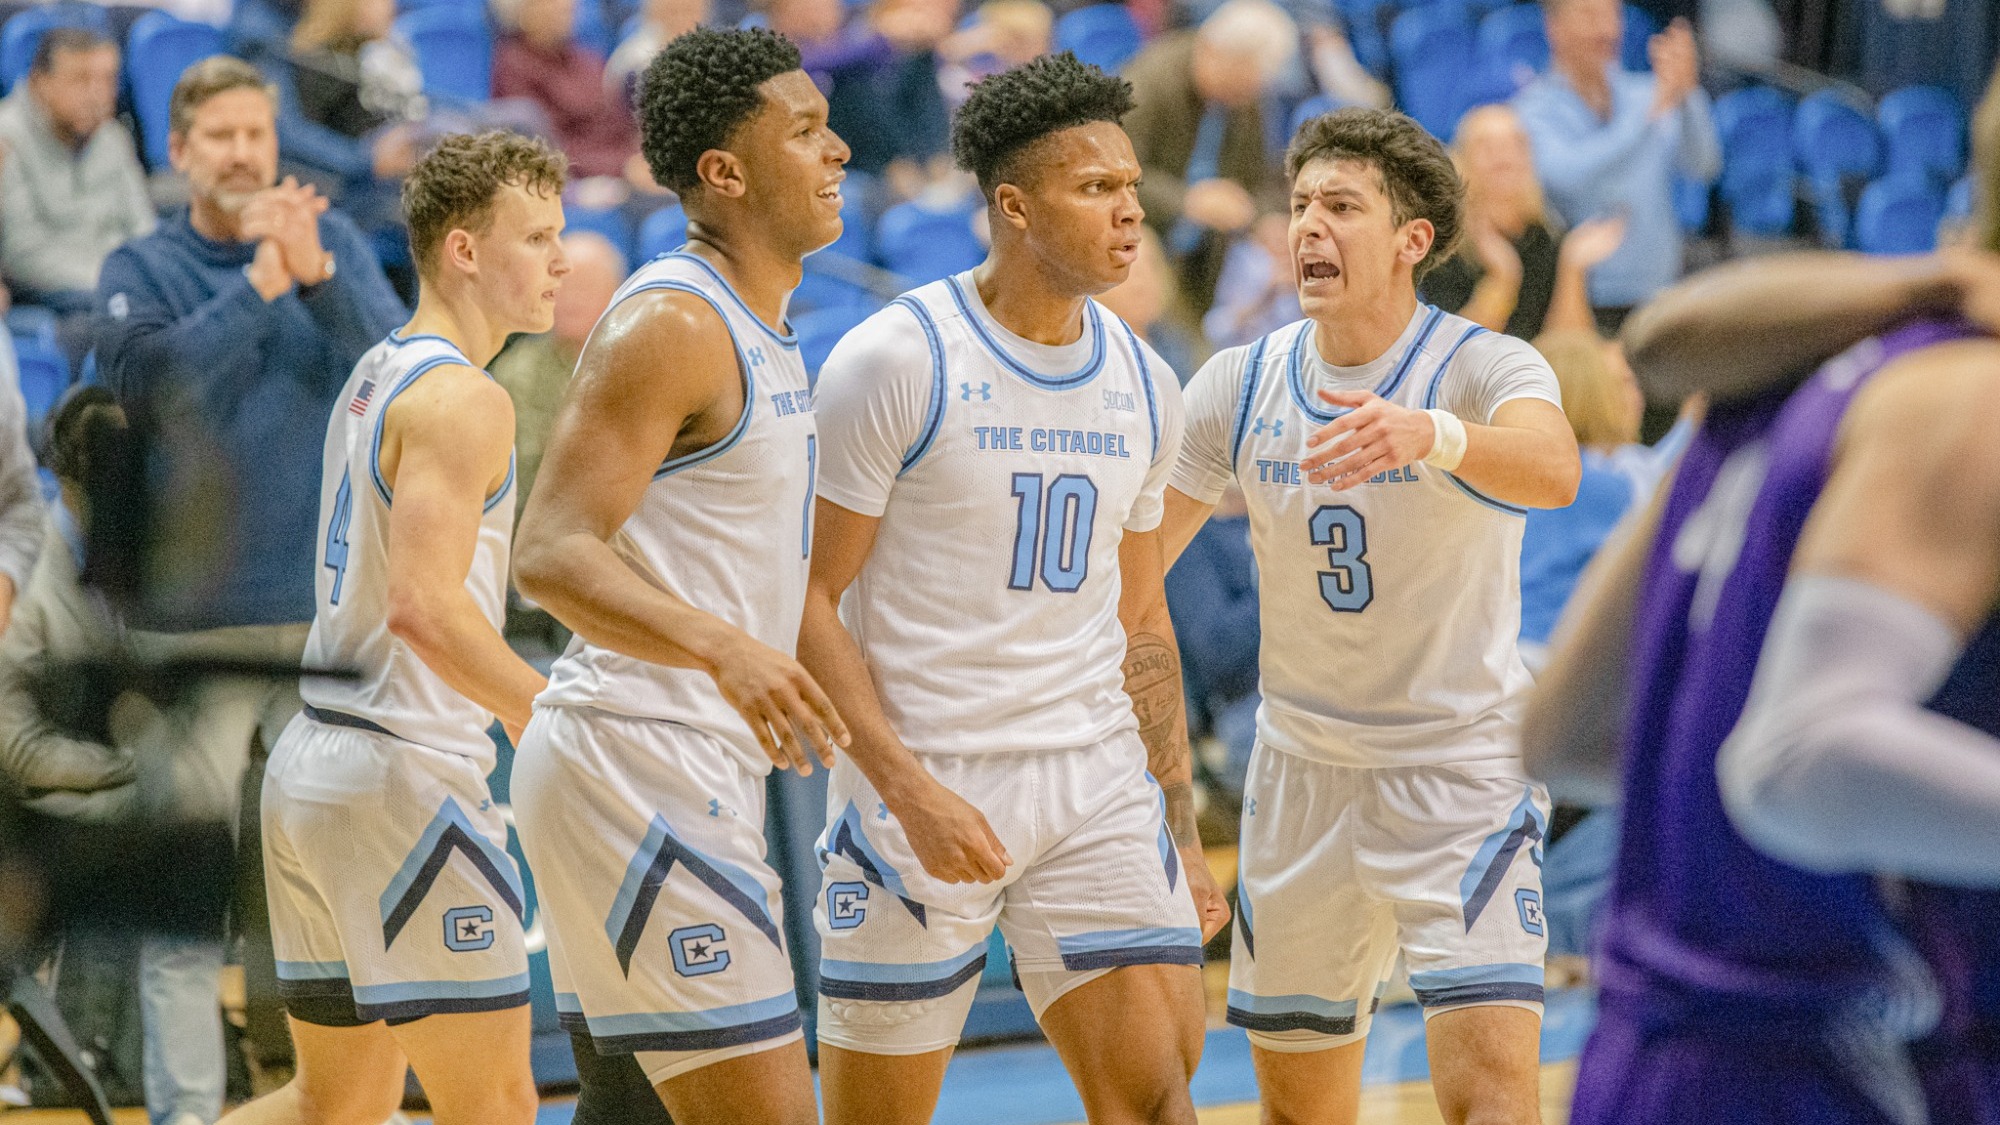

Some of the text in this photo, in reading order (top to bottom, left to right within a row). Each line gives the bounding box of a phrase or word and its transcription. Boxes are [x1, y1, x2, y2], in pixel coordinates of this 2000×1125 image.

[771, 391, 797, 417] THE
[974, 426, 1130, 458] THE CITADEL
[1256, 459, 1302, 485] THE
[324, 460, 353, 606] 4
[1007, 472, 1098, 593] 10
[1308, 504, 1374, 613] 3
[443, 905, 495, 953] C
[826, 880, 869, 931] C
[667, 923, 731, 978] C
